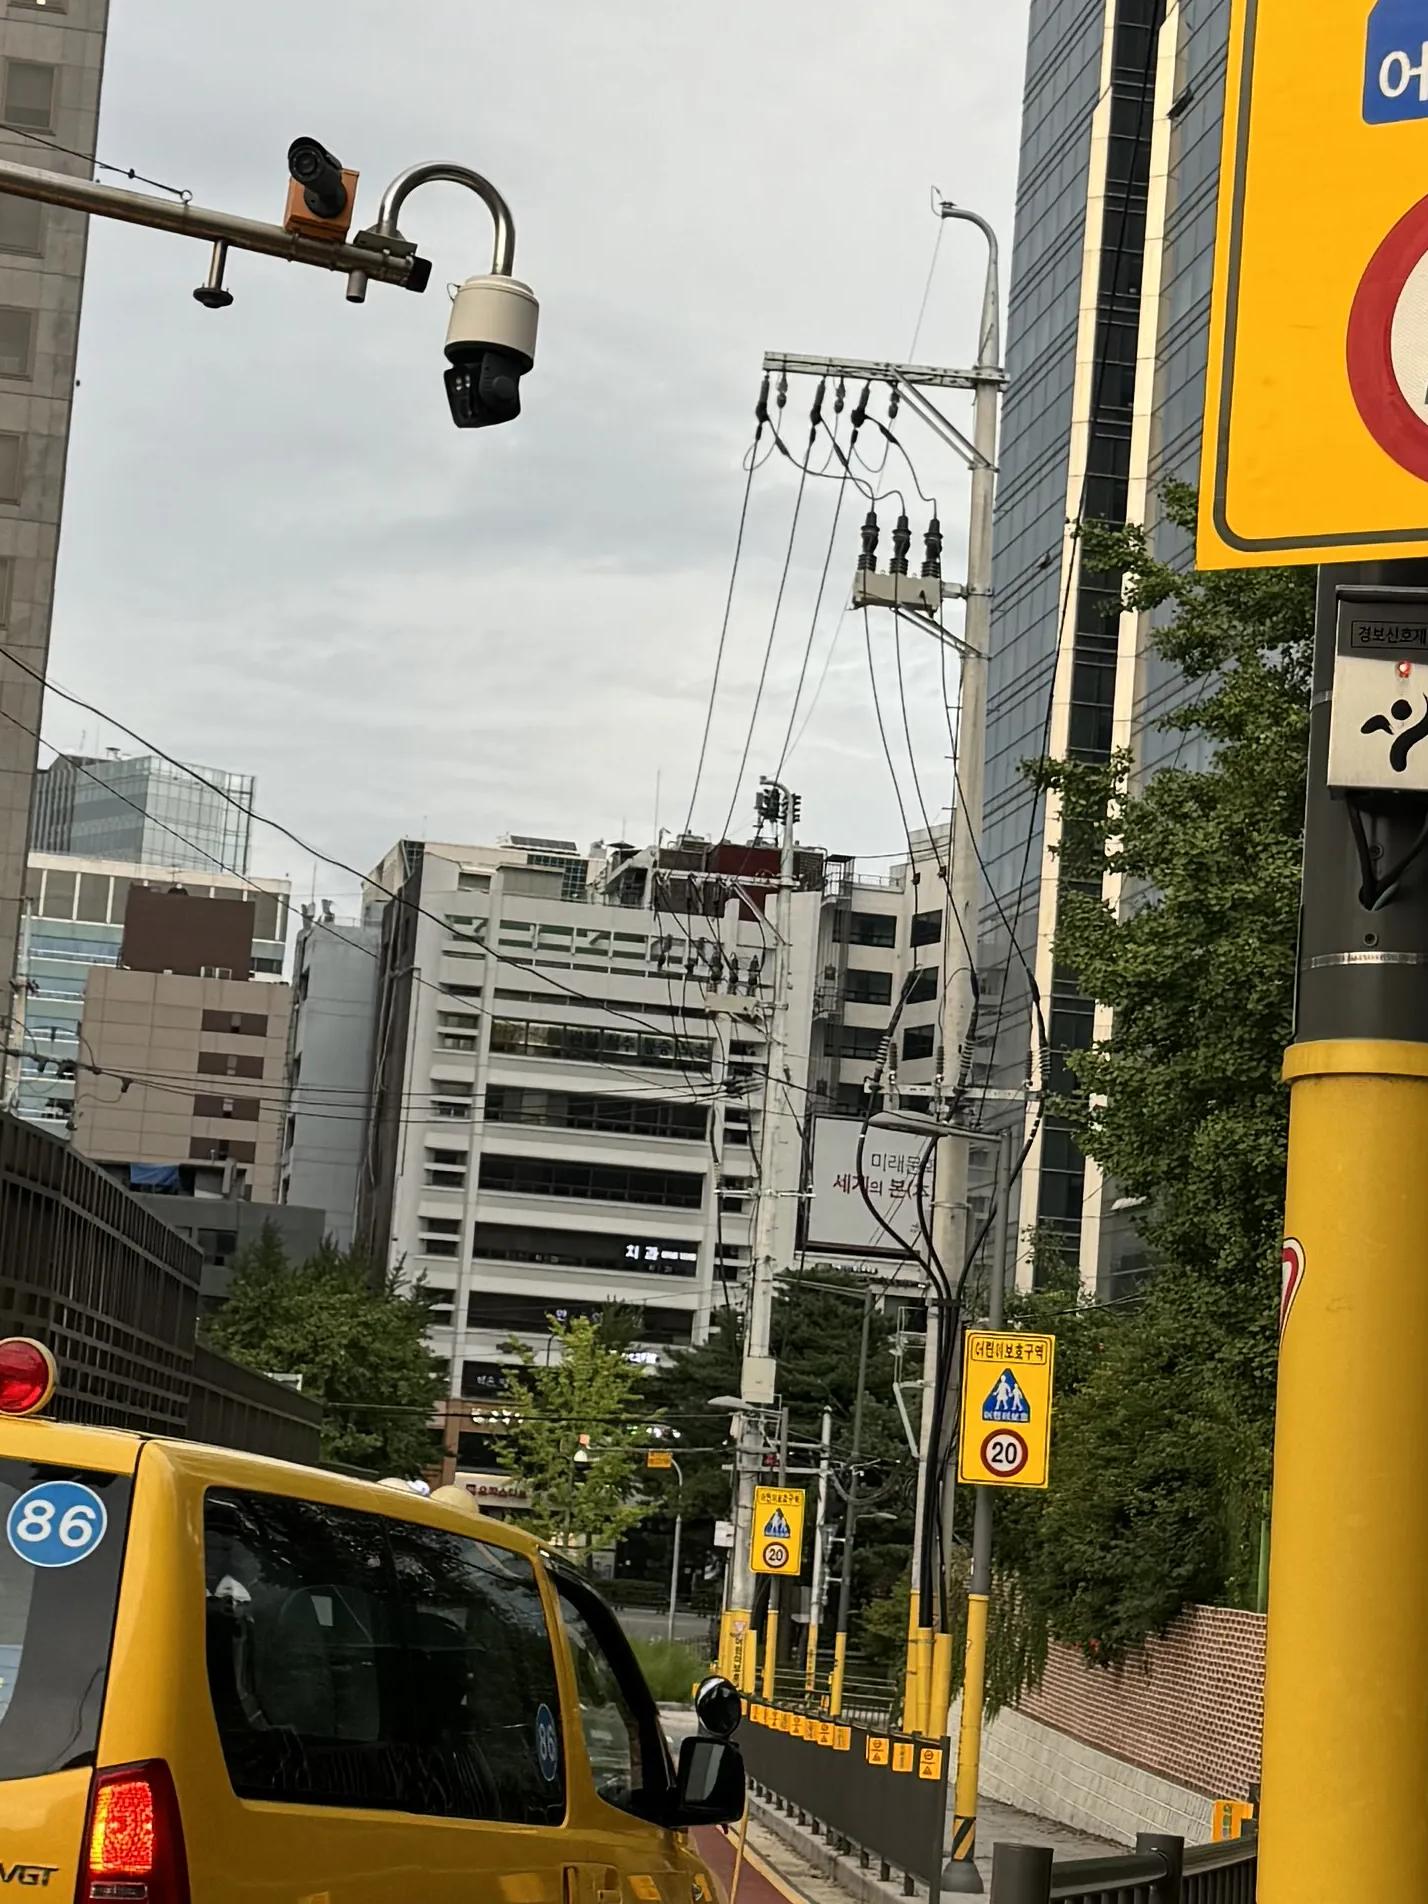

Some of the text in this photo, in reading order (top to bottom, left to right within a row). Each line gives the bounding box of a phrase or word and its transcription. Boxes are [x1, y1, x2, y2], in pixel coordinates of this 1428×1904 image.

[975, 1341, 1044, 1360] 어린이보호구역
[991, 1441, 1018, 1465] 20
[16, 1499, 96, 1548] 86
[768, 1548, 784, 1562] 20
[538, 1722, 557, 1763] 86
